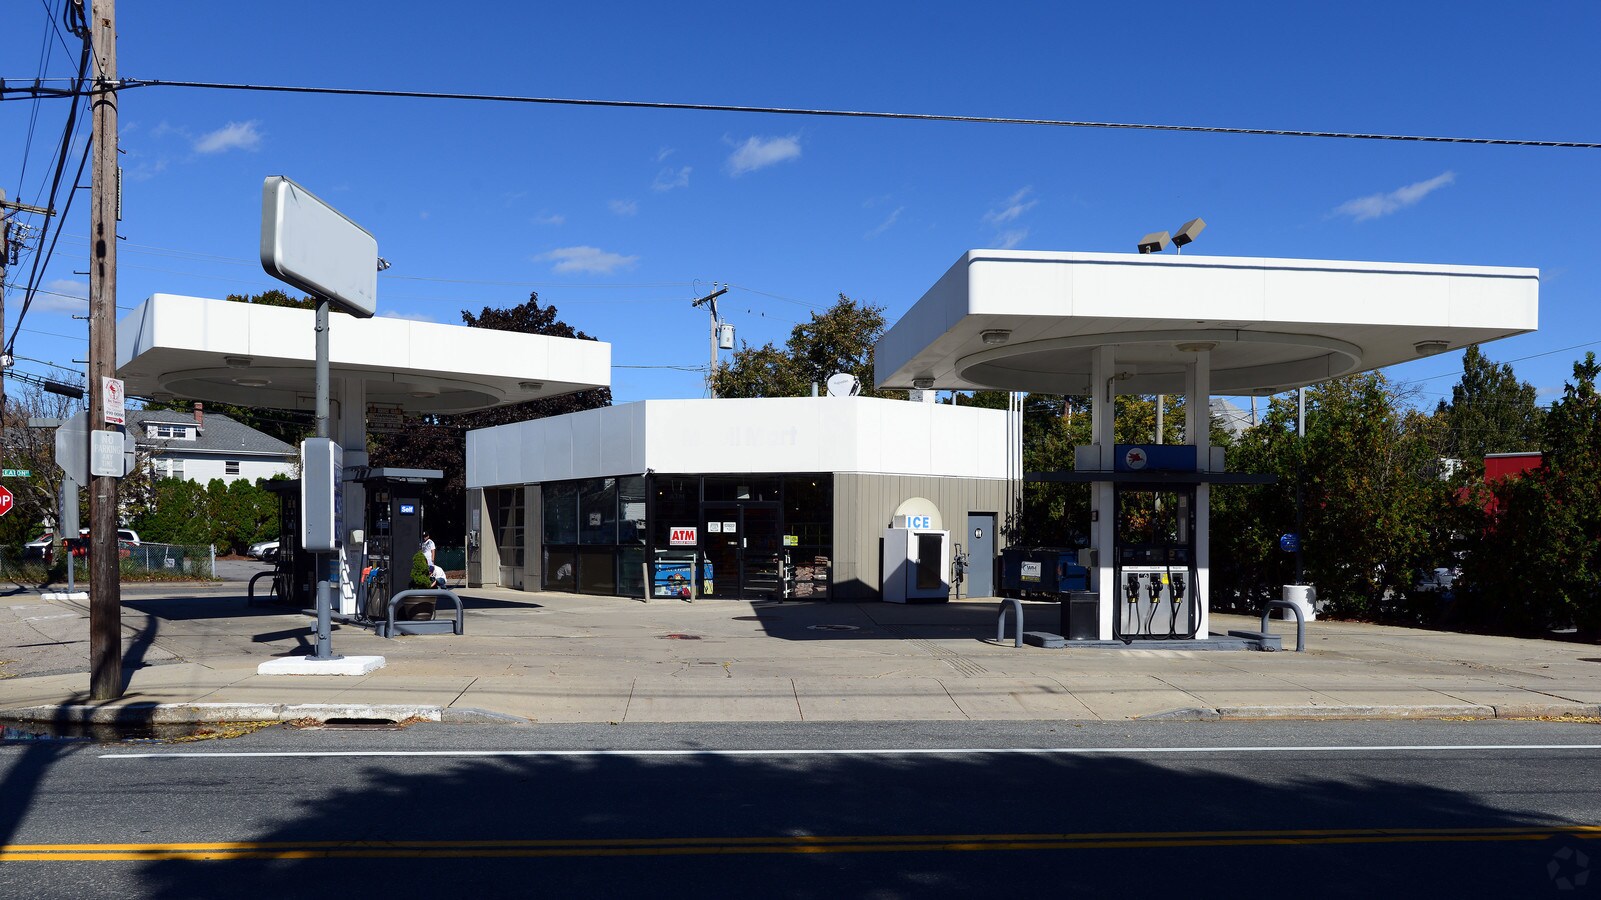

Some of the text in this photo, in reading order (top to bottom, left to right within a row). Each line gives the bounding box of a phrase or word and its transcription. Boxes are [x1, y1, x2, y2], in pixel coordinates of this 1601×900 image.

[102, 434, 114, 445] NO
[94, 444, 122, 455] PARKING
[102, 453, 114, 461] ANY
[907, 516, 929, 529] ICE
[671, 530, 695, 541] ATM
